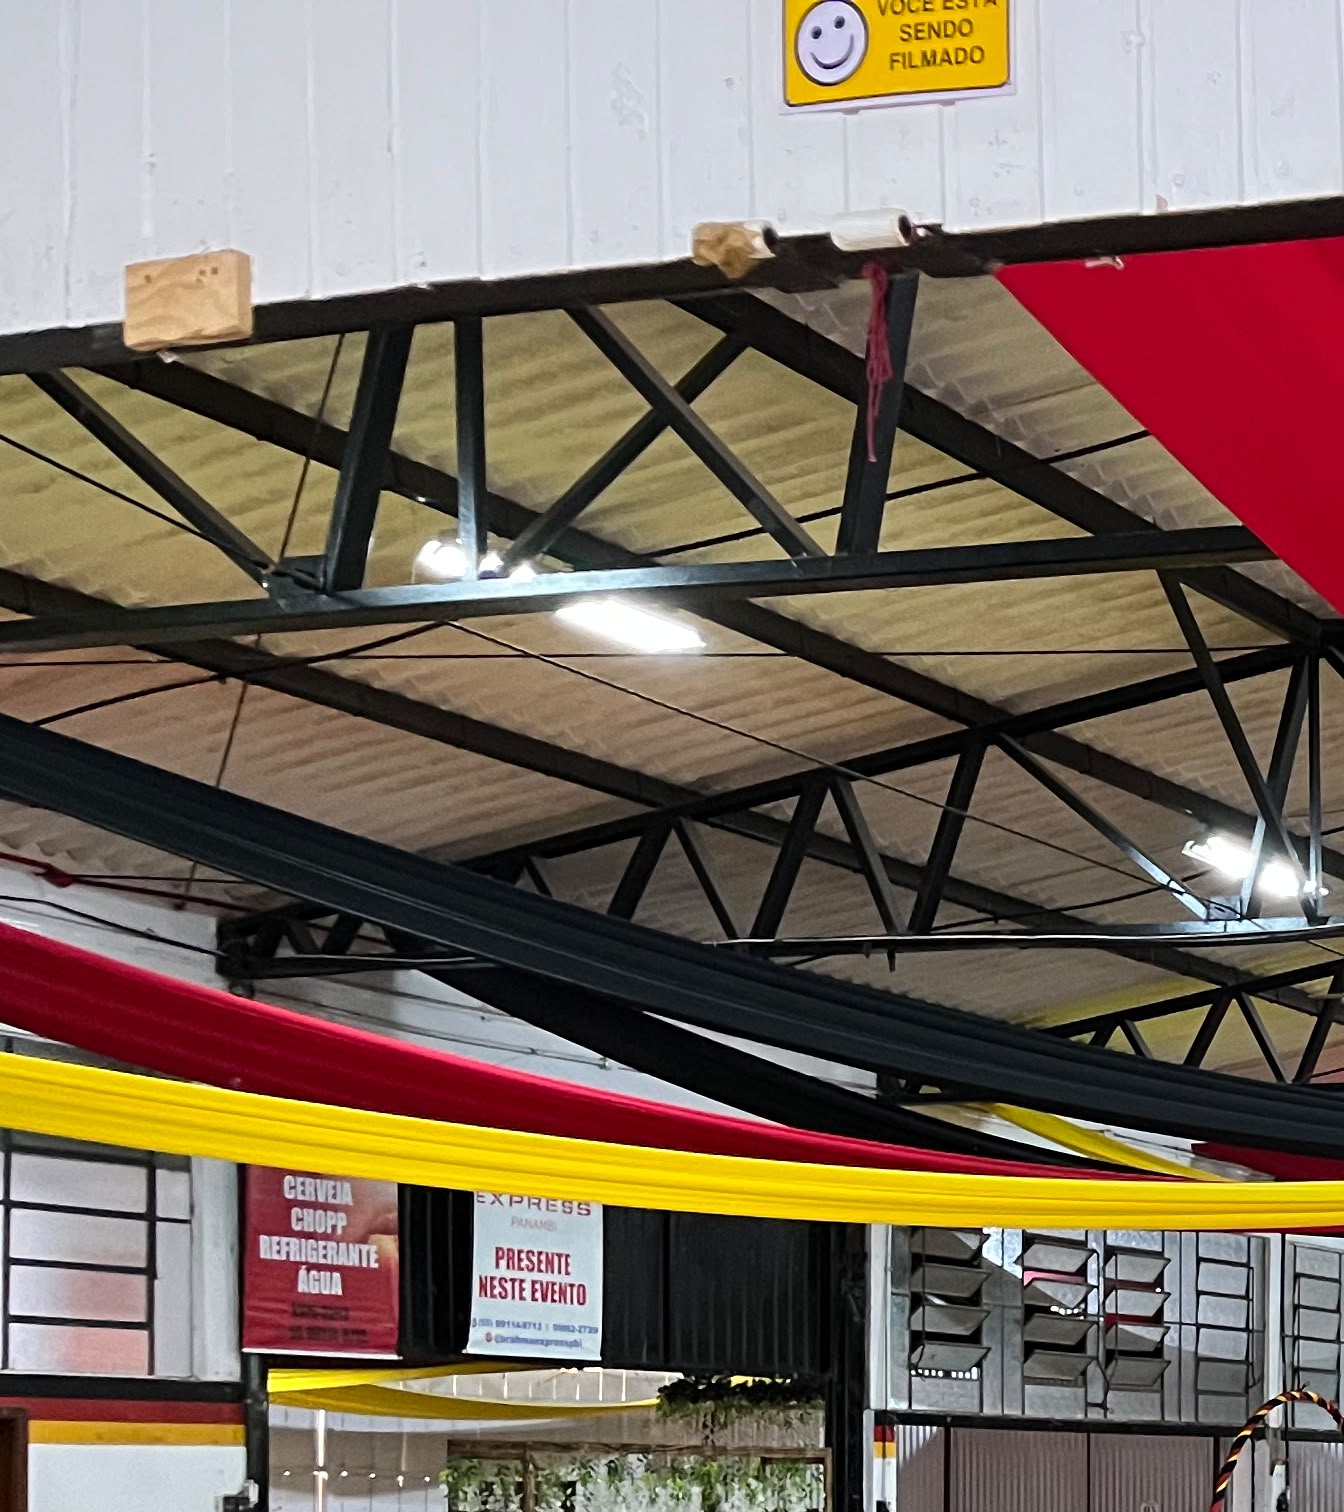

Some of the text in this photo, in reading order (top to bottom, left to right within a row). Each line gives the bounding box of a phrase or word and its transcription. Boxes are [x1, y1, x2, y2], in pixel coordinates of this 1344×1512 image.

[899, 18, 974, 42] SENDO
[889, 45, 985, 71] FILMADO
[476, 1190, 592, 1216] EXPRESS
[291, 1207, 347, 1235] CHOPP
[259, 1234, 379, 1269] REFRIGERANTE
[495, 1246, 571, 1276] PRESENTE
[298, 1265, 343, 1295] ÁGUA
[479, 1275, 587, 1306] NESTE EVENTO
